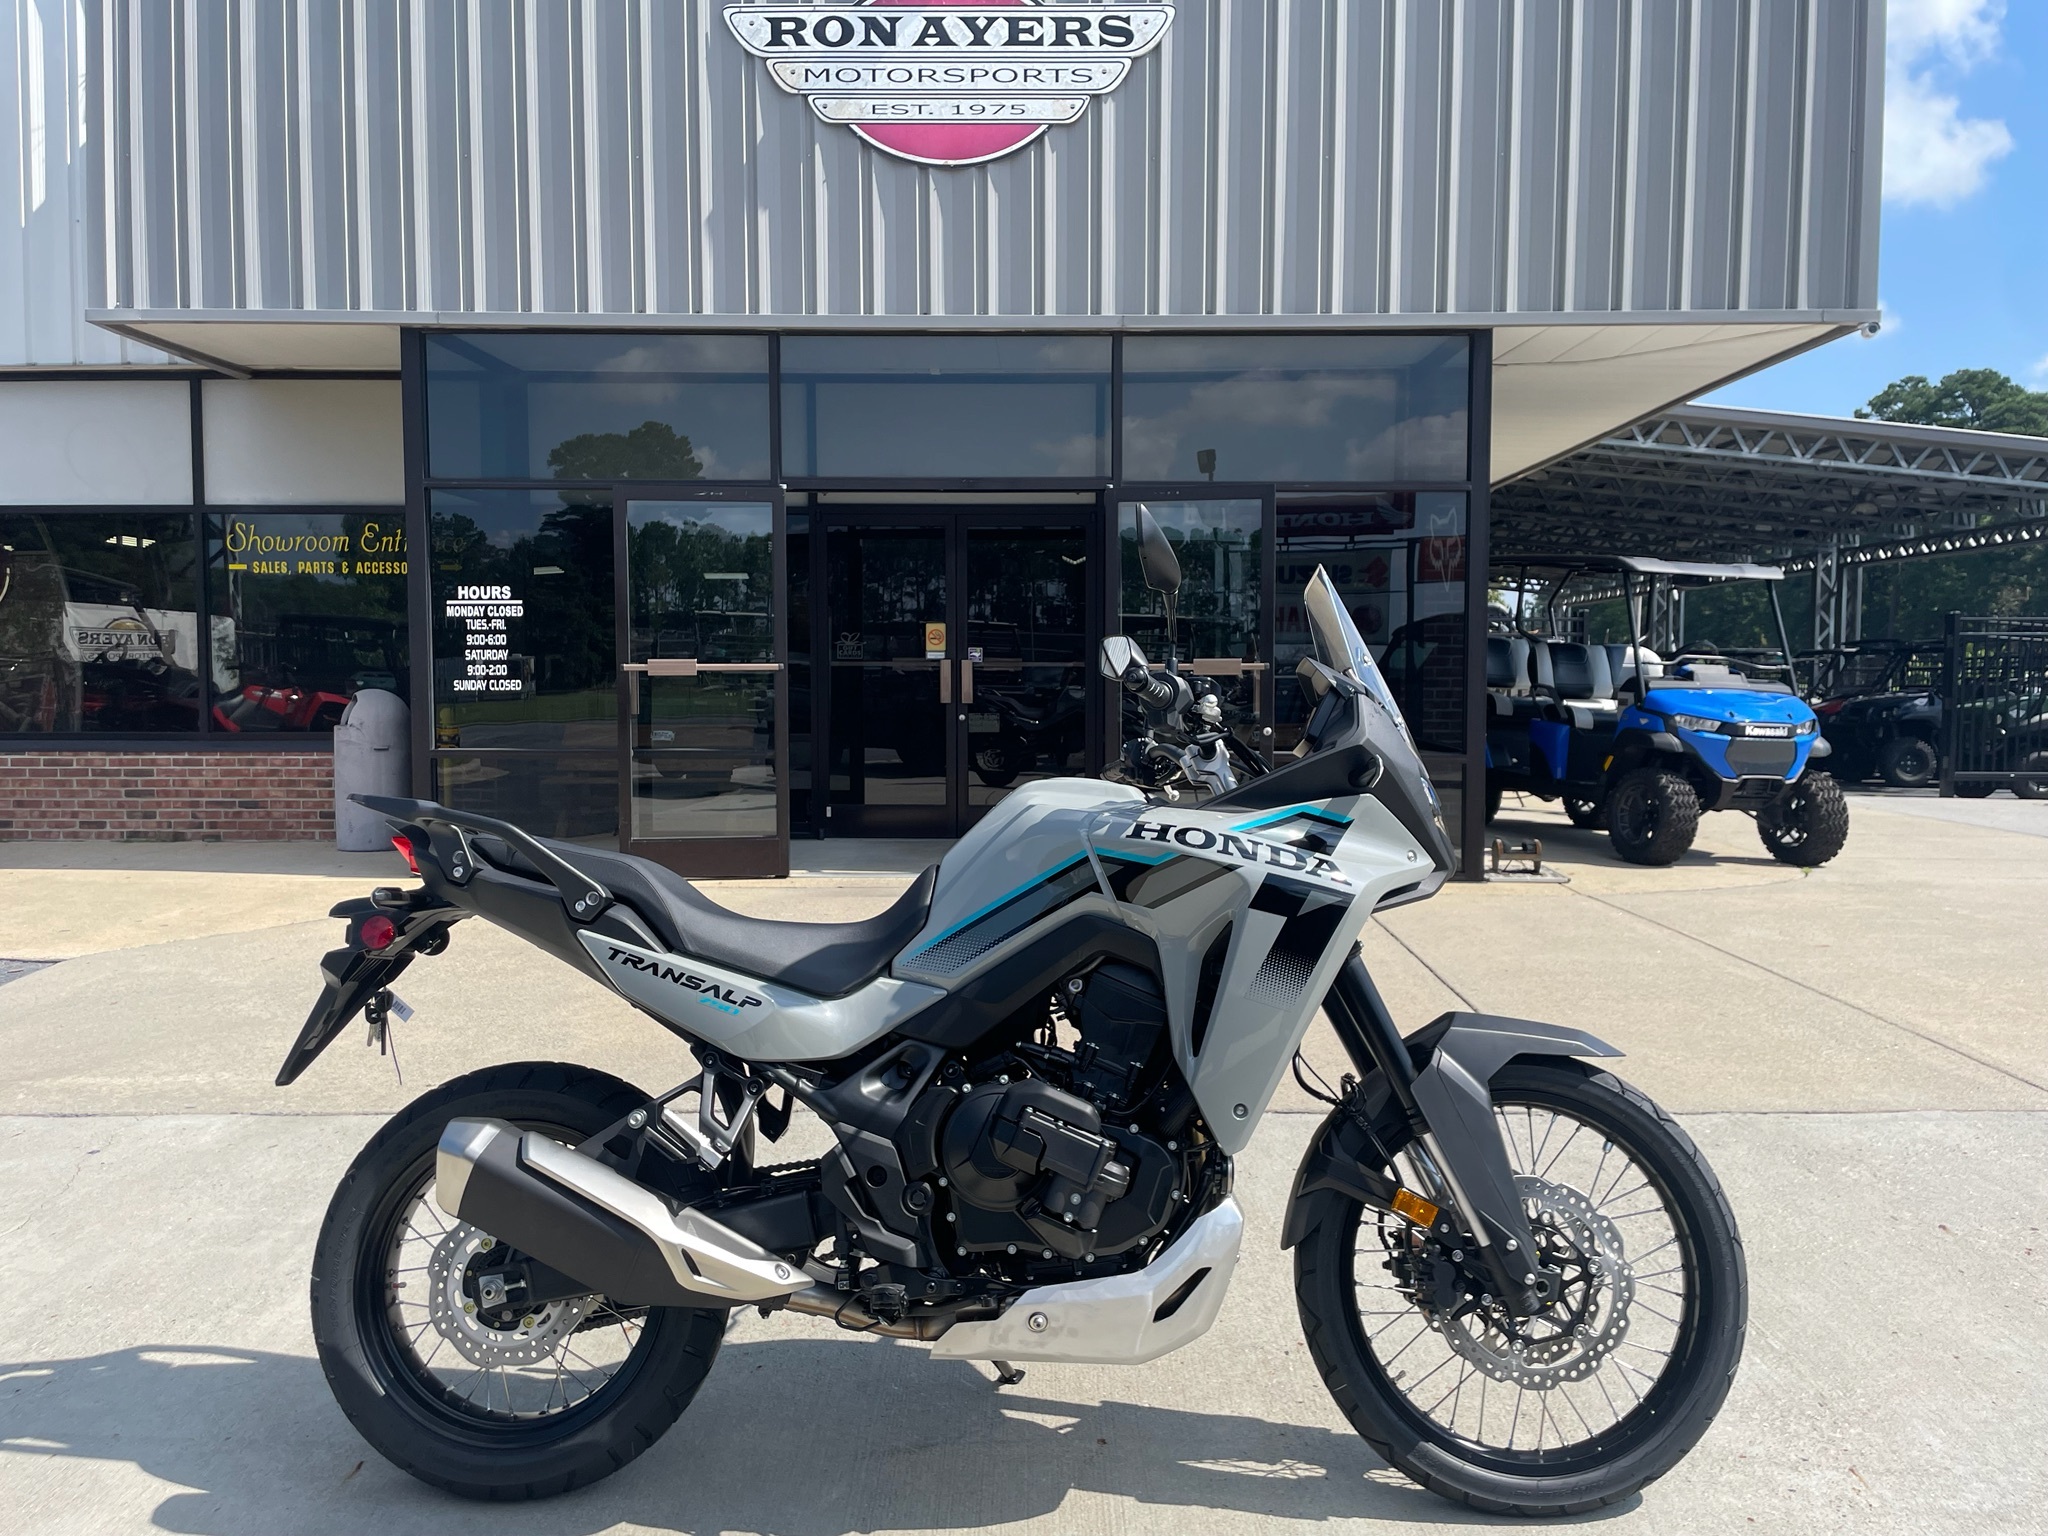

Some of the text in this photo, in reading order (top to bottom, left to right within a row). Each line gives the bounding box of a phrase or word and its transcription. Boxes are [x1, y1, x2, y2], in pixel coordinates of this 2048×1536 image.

[763, 16, 1135, 47] RON AYERS
[803, 67, 1093, 84] MOTORSPORTS
[871, 103, 1026, 116] EST. 1975
[226, 522, 350, 555] Showroom
[252, 561, 292, 575] SALES,
[298, 561, 335, 574] PARTS
[342, 561, 350, 574] &
[457, 585, 512, 599] HOURS
[446, 605, 524, 617] MONDAY CLOSED
[465, 618, 507, 630] TUES.-FRI.
[466, 634, 507, 645] 9:00-6:00
[465, 649, 509, 660] SATURDAY
[467, 664, 508, 676] 9:00-2:00
[453, 679, 522, 691] SUNDAY CLOSED
[1745, 725, 1788, 737] Kawasaki
[1125, 821, 1353, 887] HONDA
[607, 946, 763, 1010] TRANSALP
